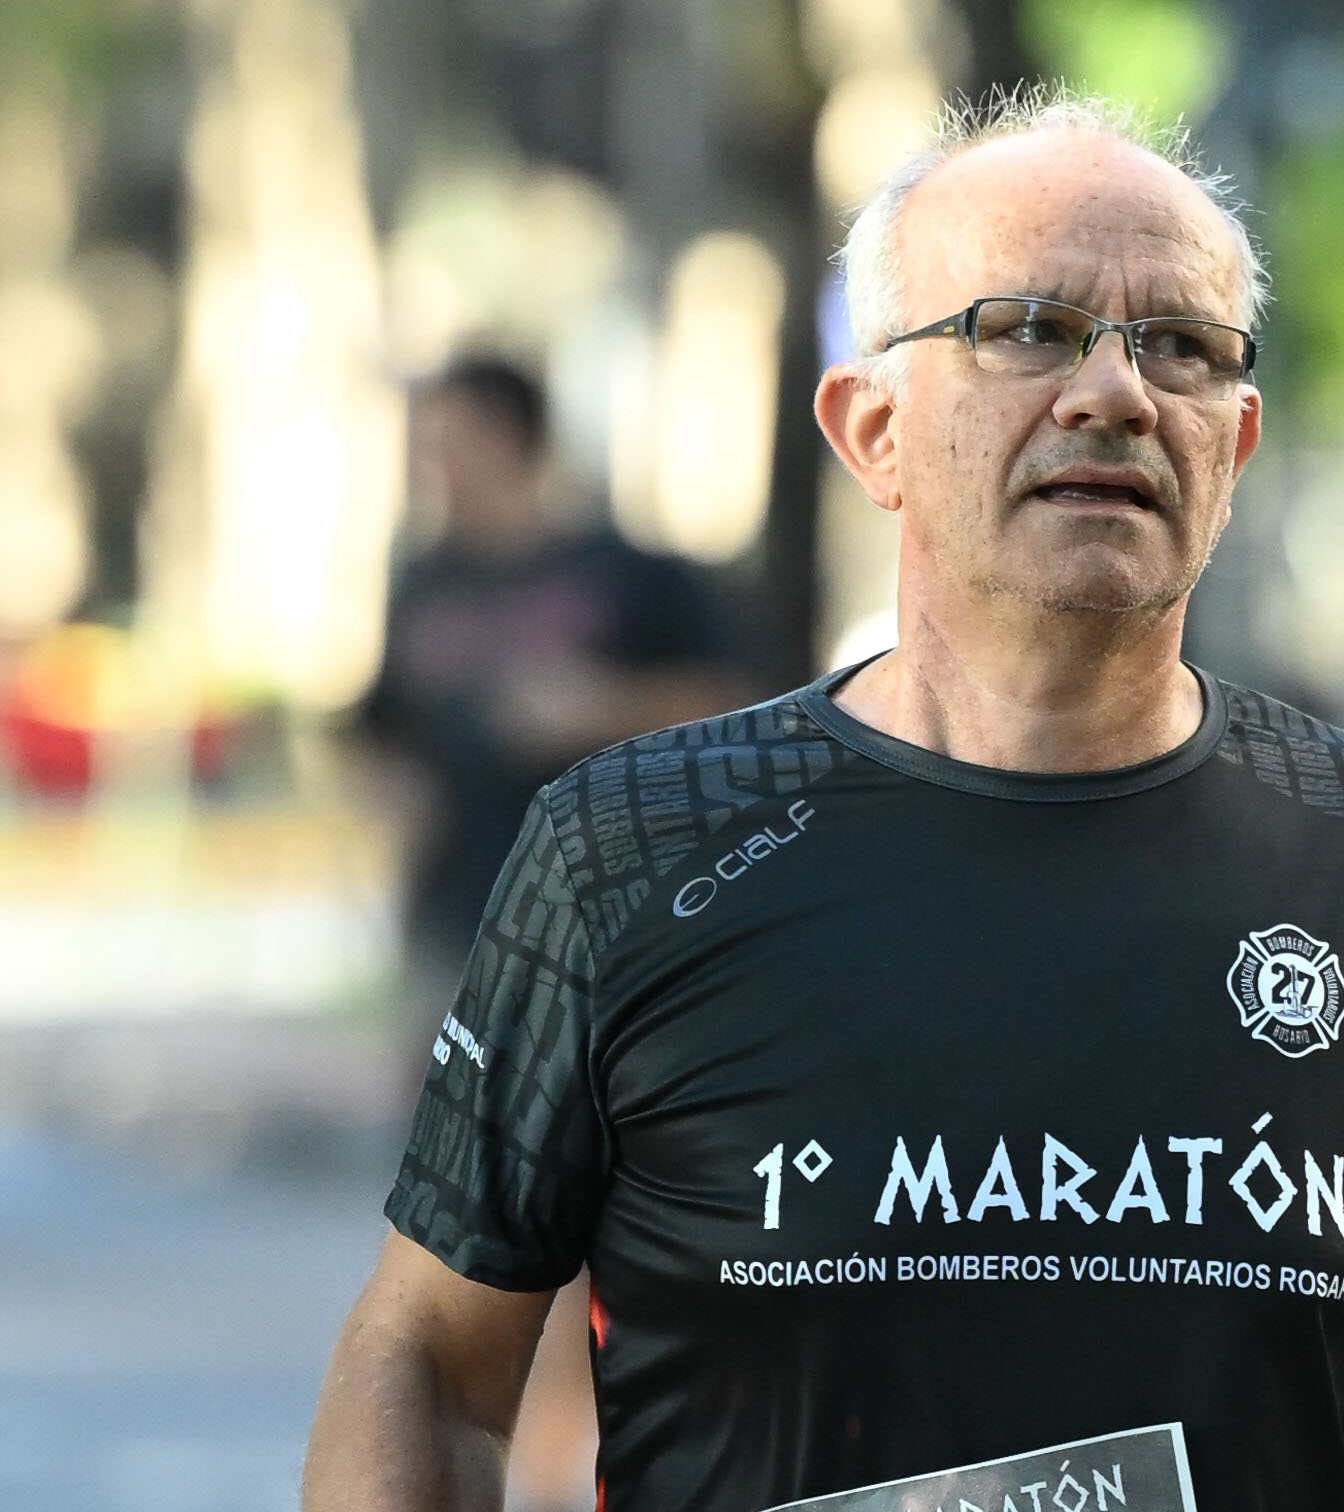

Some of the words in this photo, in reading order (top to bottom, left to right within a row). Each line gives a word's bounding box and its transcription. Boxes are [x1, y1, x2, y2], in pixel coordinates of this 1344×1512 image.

[1265, 935, 1315, 957] BOMBEROS
[1271, 961, 1316, 1006] 27
[1272, 1024, 1311, 1045] ROSARIO
[719, 1251, 887, 1288] ASOCIACIÓN
[896, 1254, 1061, 1282] BOMBEROS
[1069, 1255, 1272, 1290] VOLUNTARIOS
